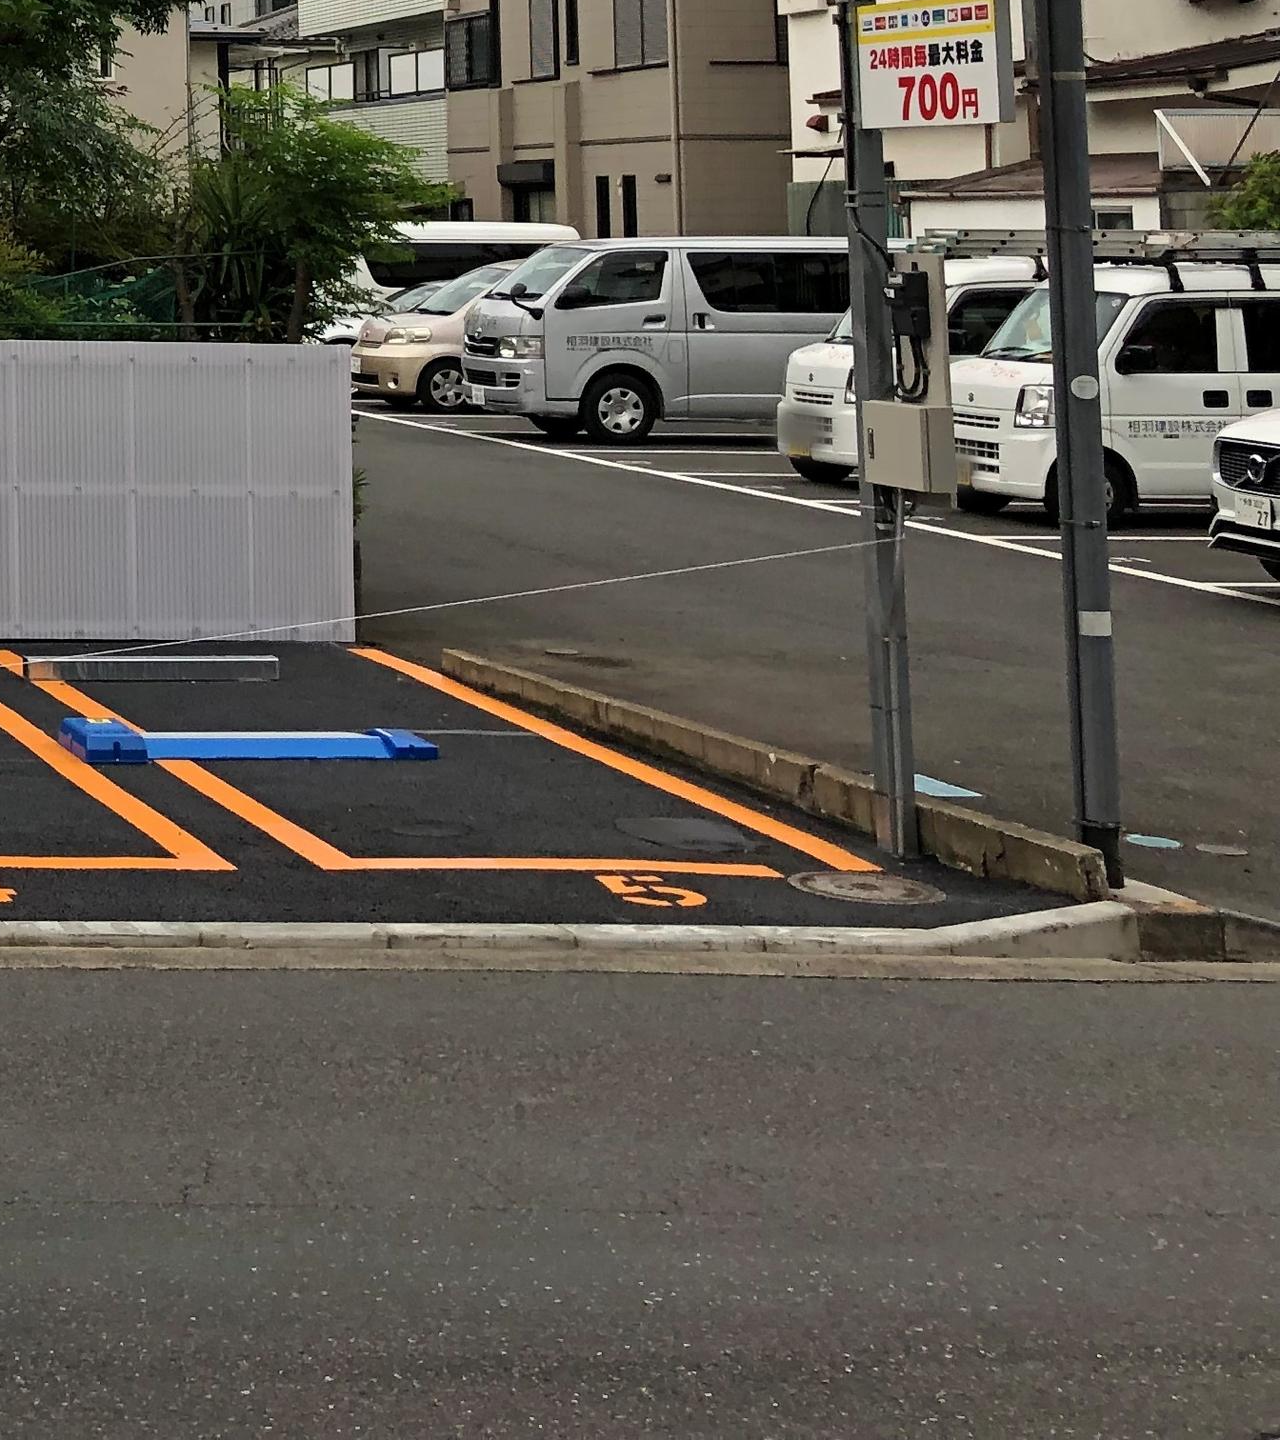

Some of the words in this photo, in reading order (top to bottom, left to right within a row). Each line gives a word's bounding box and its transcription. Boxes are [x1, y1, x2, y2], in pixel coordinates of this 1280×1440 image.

[870, 40, 984, 70] 24時間毎最大料金
[898, 72, 979, 120] 700円
[595, 875, 707, 907] 5
